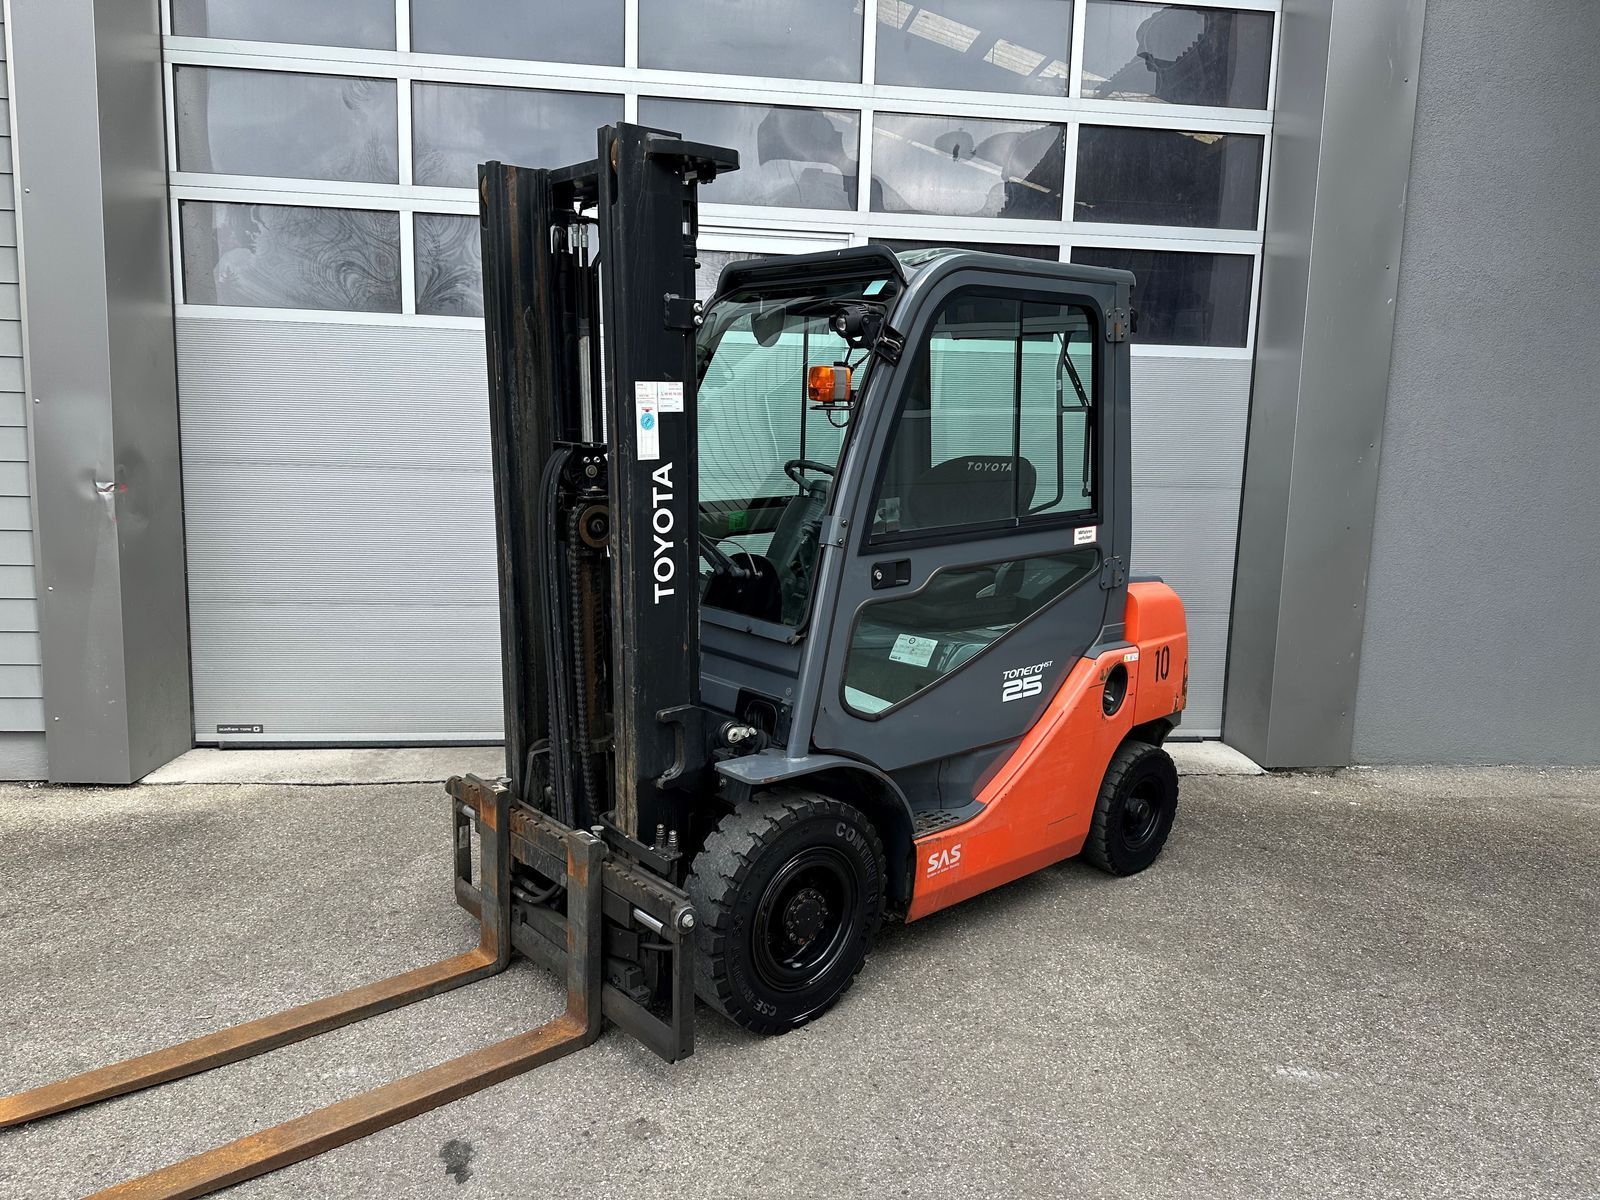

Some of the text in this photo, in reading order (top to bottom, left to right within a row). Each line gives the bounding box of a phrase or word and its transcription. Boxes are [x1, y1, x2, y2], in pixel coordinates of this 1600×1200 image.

[967, 461, 1013, 472] TOYOTA
[652, 462, 675, 605] TOYOTA
[1155, 645, 1170, 684] 10
[1002, 674, 1043, 703] 25
[927, 843, 962, 873] SAS
